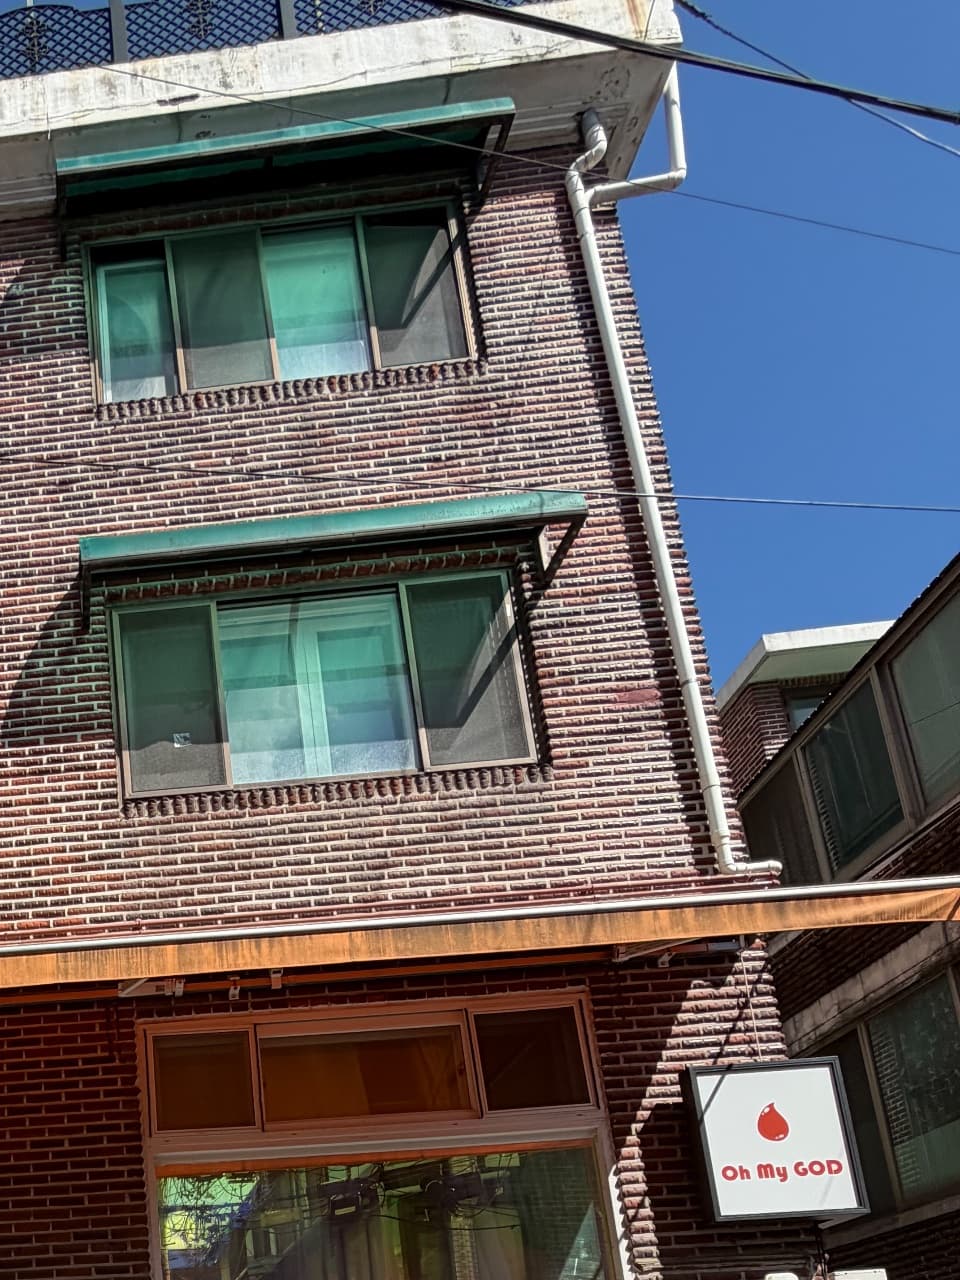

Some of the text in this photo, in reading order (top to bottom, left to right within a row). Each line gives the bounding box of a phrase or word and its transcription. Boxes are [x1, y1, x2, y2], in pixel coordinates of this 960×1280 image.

[721, 1159, 843, 1183] Oh My GOD
